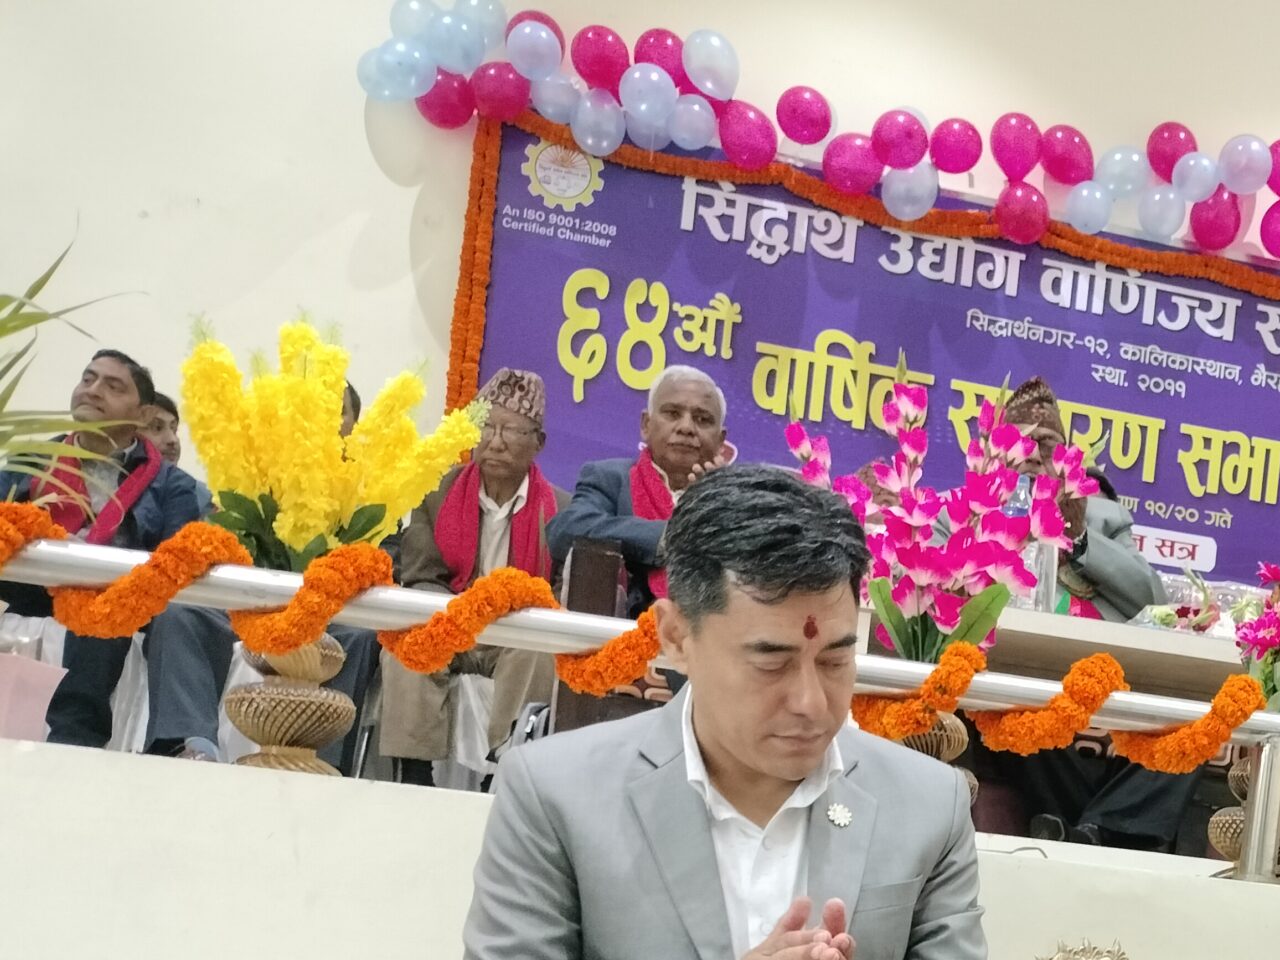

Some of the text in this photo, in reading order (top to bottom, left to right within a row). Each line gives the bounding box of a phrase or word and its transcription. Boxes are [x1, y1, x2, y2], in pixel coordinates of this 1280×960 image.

[502, 217, 612, 249] Certified Chamber
[503, 204, 617, 237] An ISO 9001:2008
[1137, 374, 1188, 398] २०११
[1204, 508, 1234, 529] गते
[1154, 537, 1200, 562] सत्र
